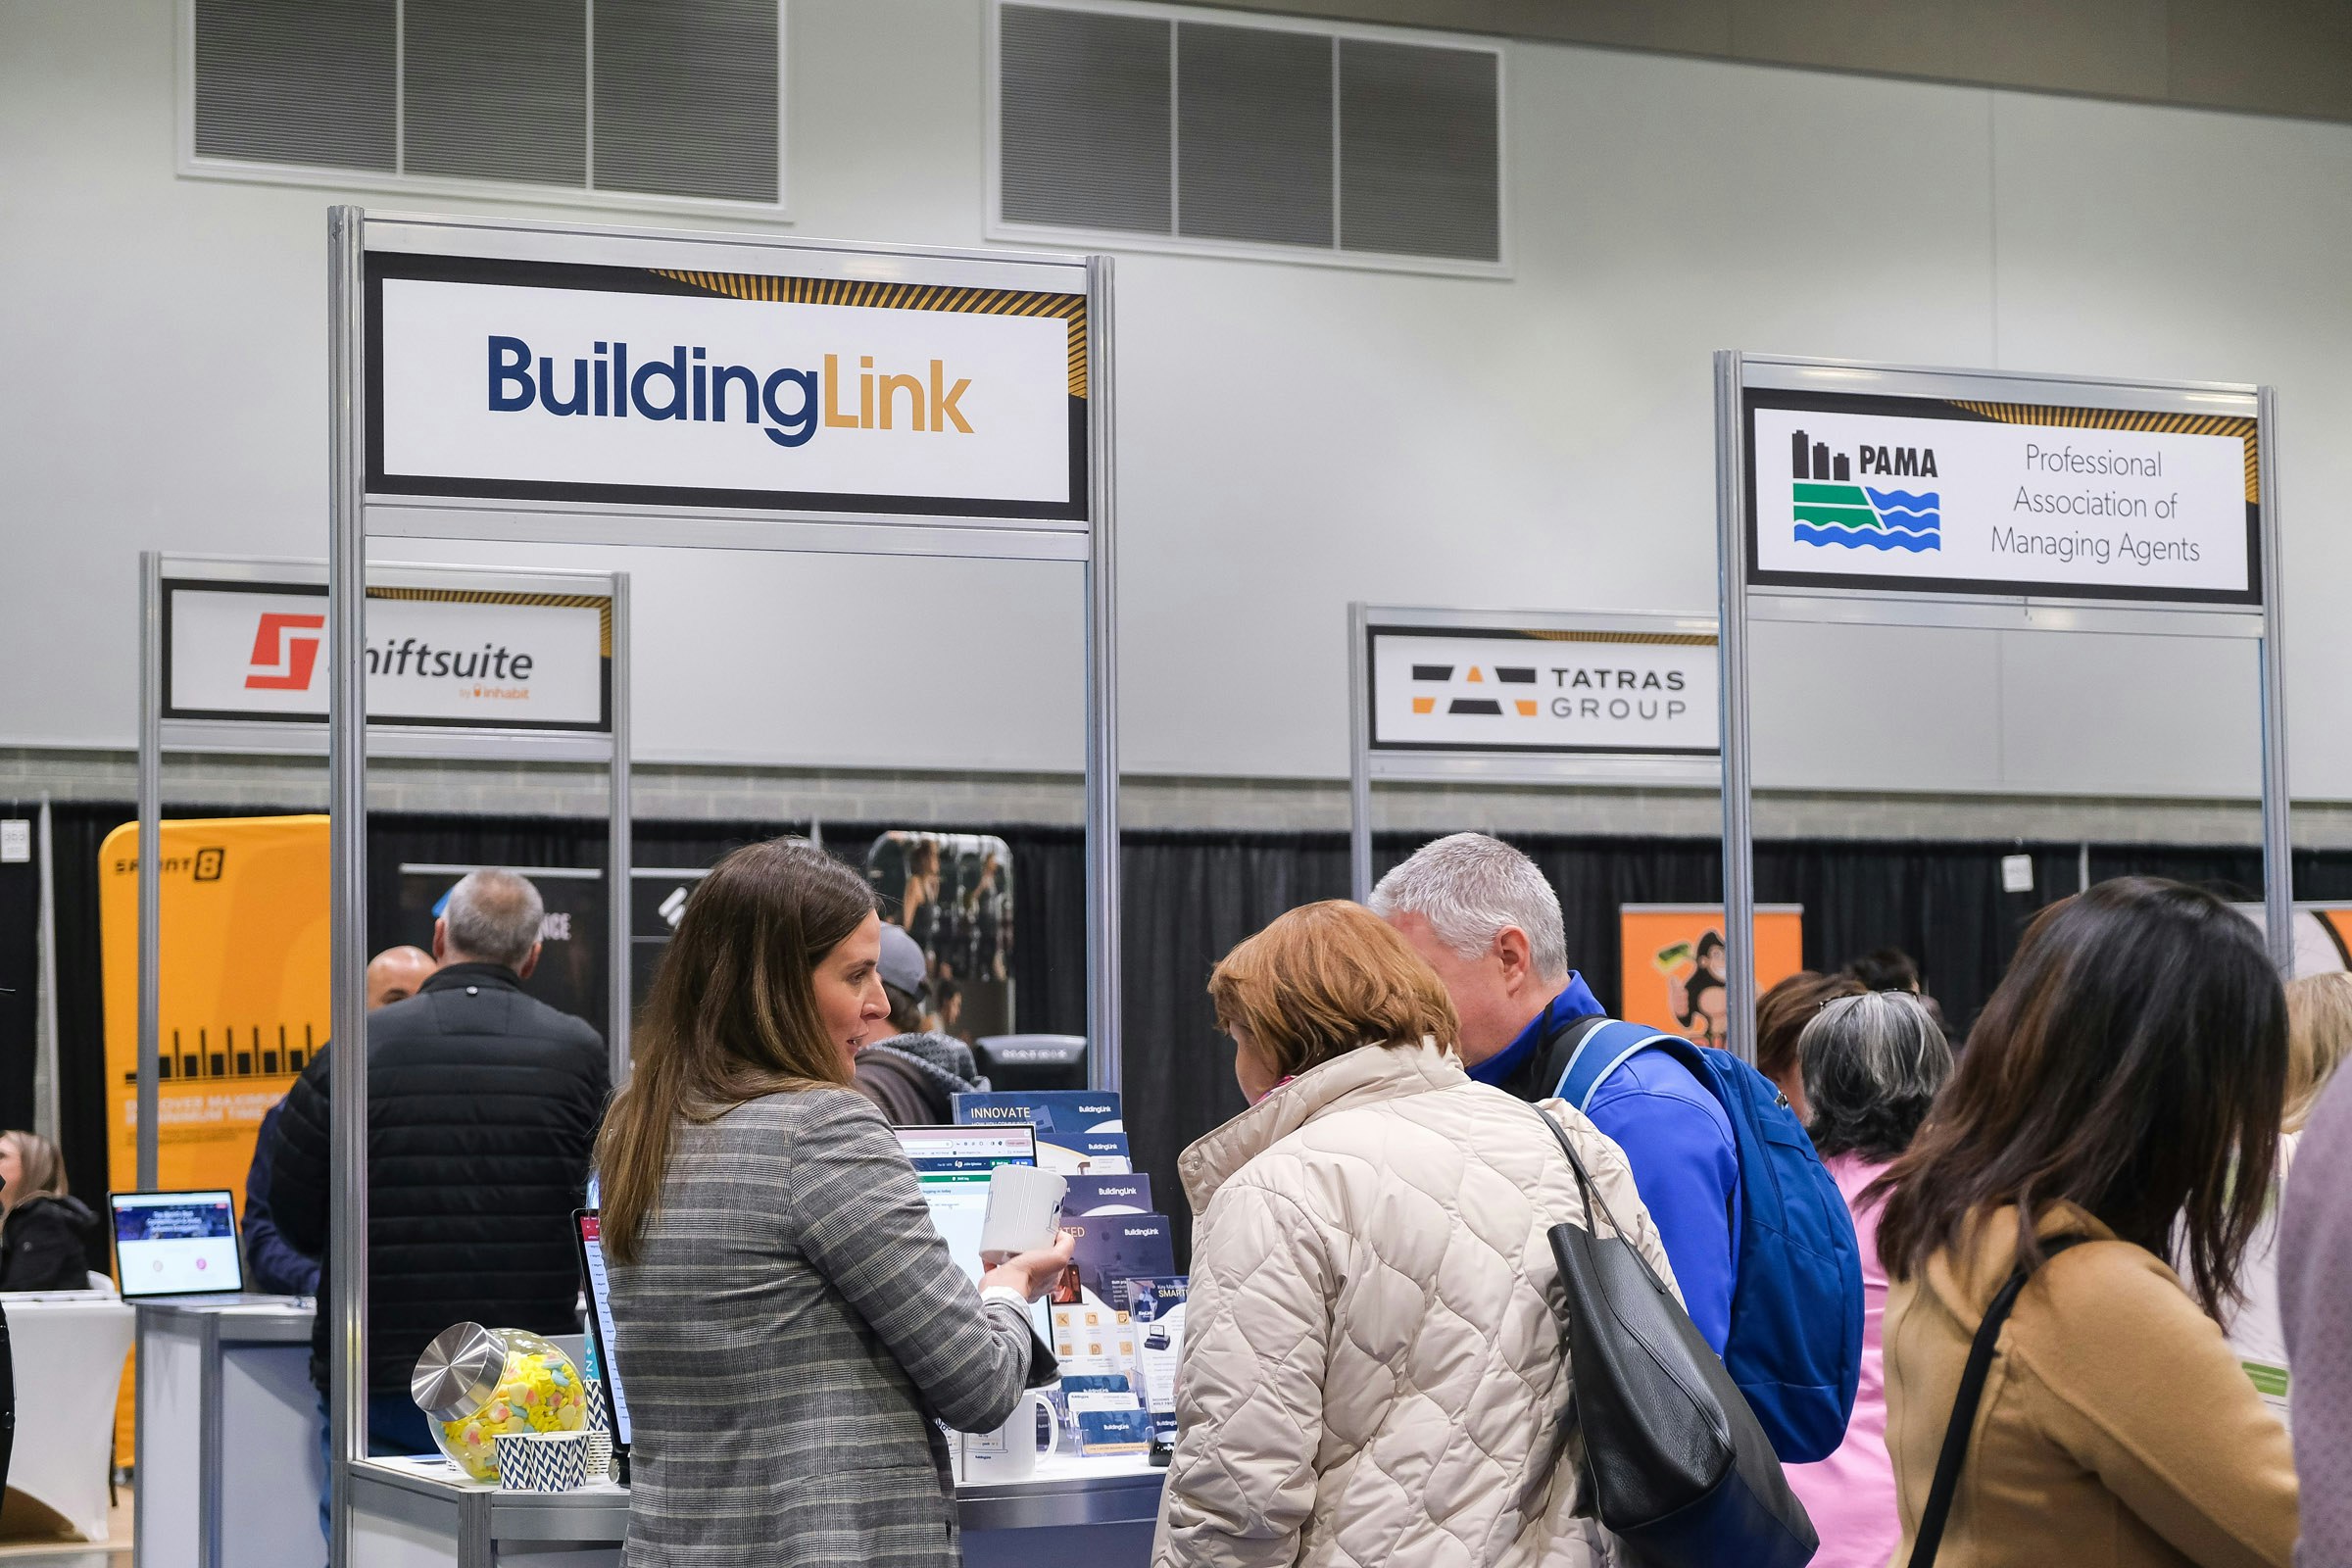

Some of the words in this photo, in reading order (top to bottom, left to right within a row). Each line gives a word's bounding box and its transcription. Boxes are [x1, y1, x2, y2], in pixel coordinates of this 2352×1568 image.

[488, 334, 975, 447] BuildingLink
[1859, 444, 1938, 478] PAMA
[2026, 443, 2163, 478] Professional
[2013, 485, 2147, 518] Association
[2154, 492, 2179, 519] of
[1991, 526, 2111, 564] Managing
[2118, 532, 2201, 565] Agents
[366, 637, 533, 680] hiftsuite
[1551, 668, 1686, 691] TATRAS
[483, 688, 530, 700] inhabit
[1550, 697, 1687, 720] GROUP
[971, 1106, 1031, 1118] INNOVATE
[1078, 1105, 1111, 1114] BuildingLink
[1124, 1228, 1159, 1237] BuildingLink
